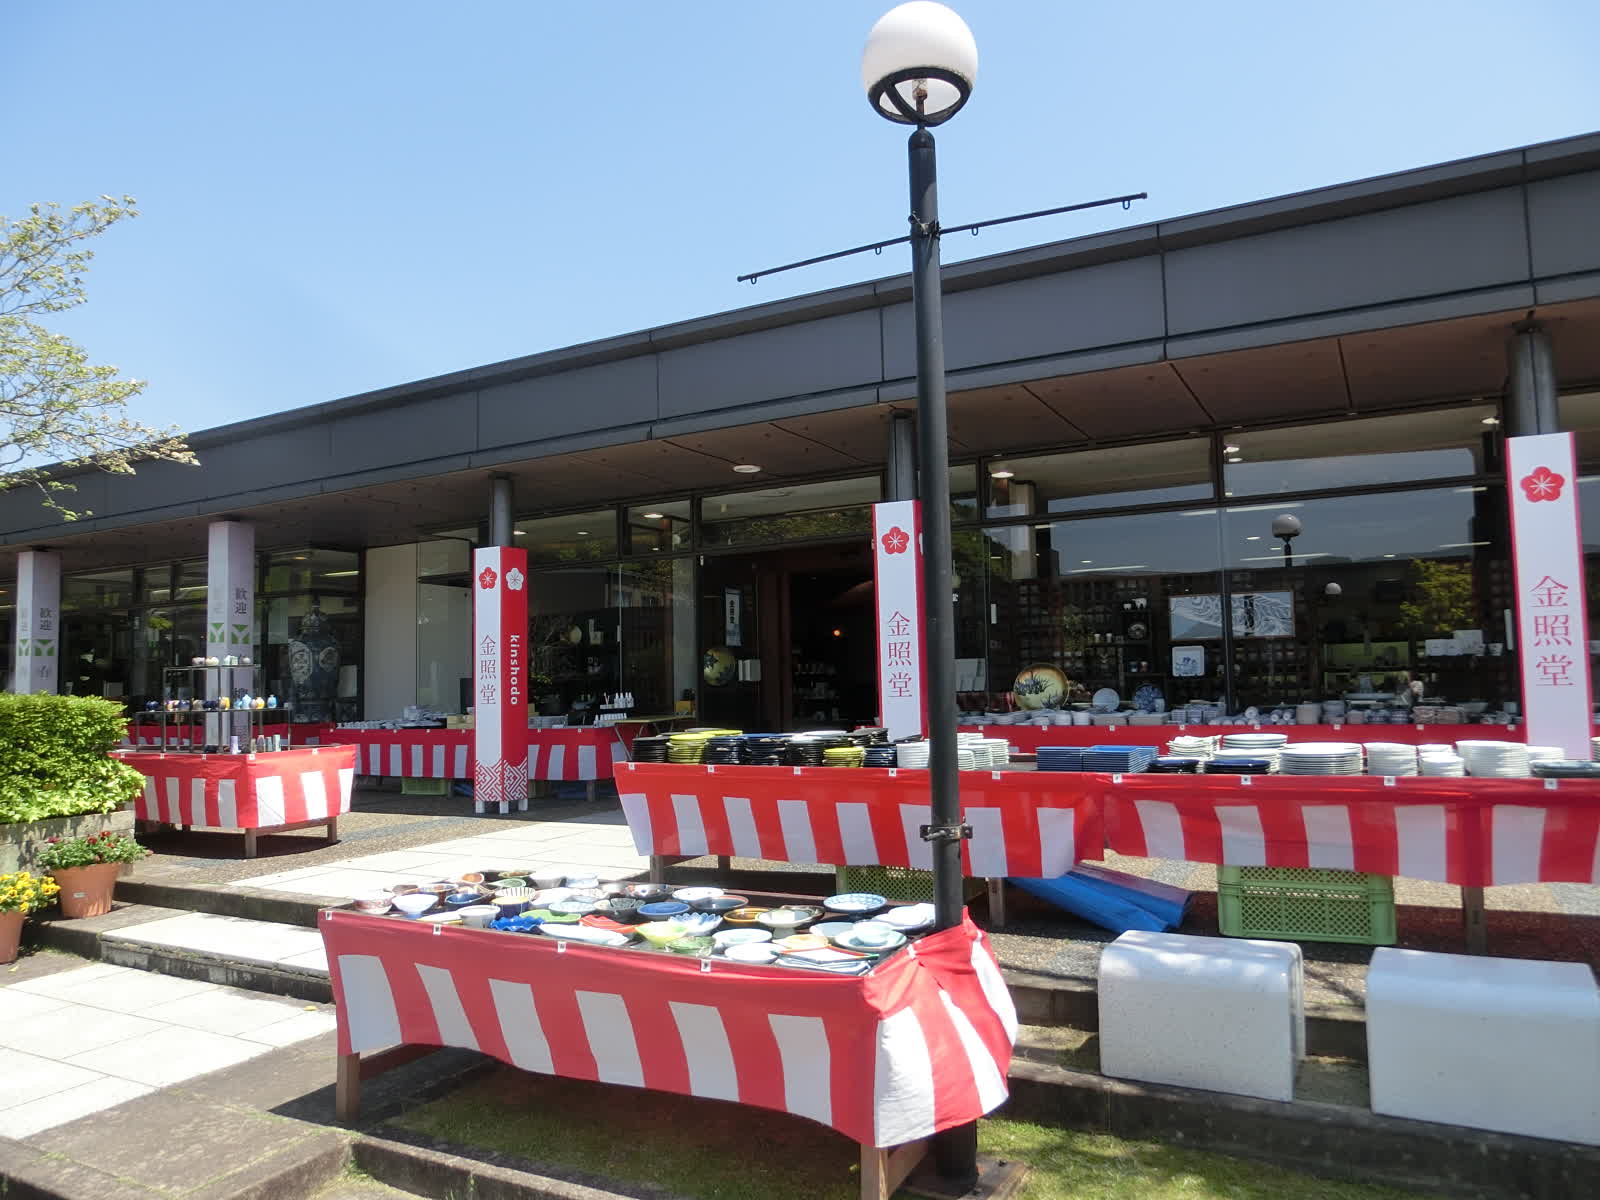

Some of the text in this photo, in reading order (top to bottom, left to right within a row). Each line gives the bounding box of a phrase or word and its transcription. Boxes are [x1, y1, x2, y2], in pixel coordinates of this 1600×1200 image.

[480, 634, 496, 705] 金照堂
[510, 634, 520, 705] kinshodo
[887, 611, 912, 698] 金照堂
[1530, 575, 1575, 687] 金照堂
